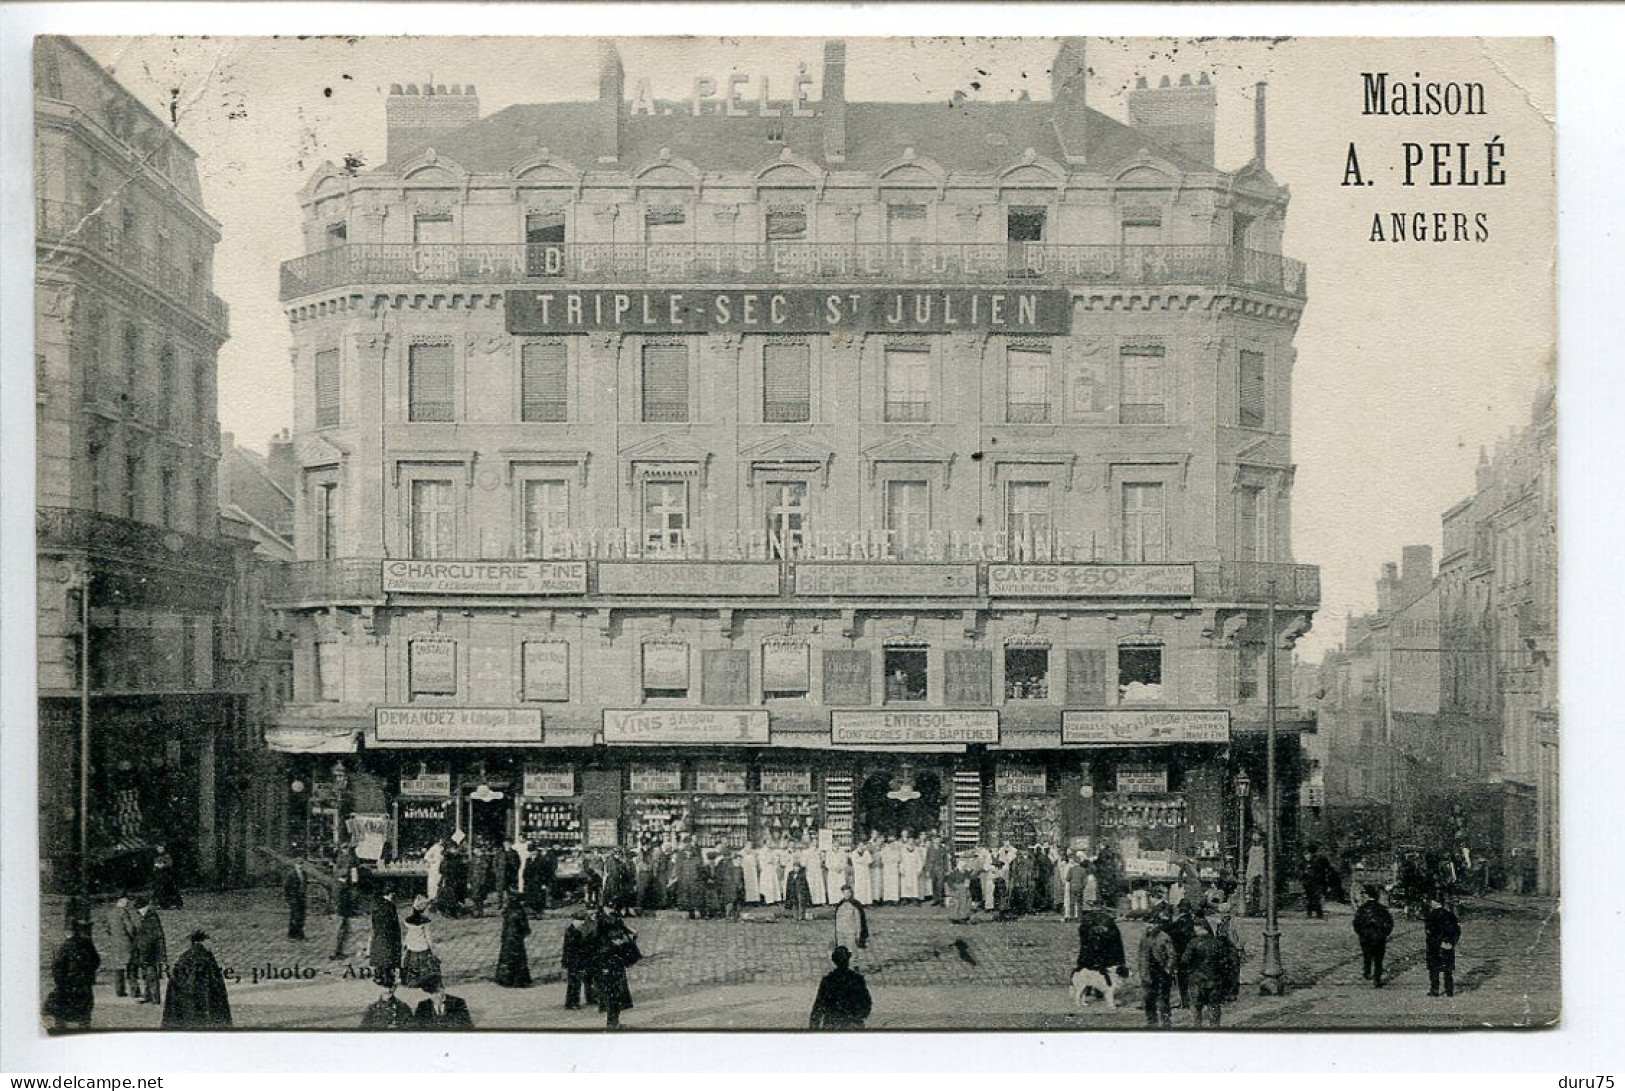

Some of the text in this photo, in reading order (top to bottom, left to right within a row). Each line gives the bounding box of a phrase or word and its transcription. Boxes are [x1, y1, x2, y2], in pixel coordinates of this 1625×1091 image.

[631, 76, 673, 117] A.
[888, 293, 1038, 326] JULIEN
[387, 562, 583, 580] CHARCUTERIE FINE
[379, 710, 456, 726] DEMANDEZ
